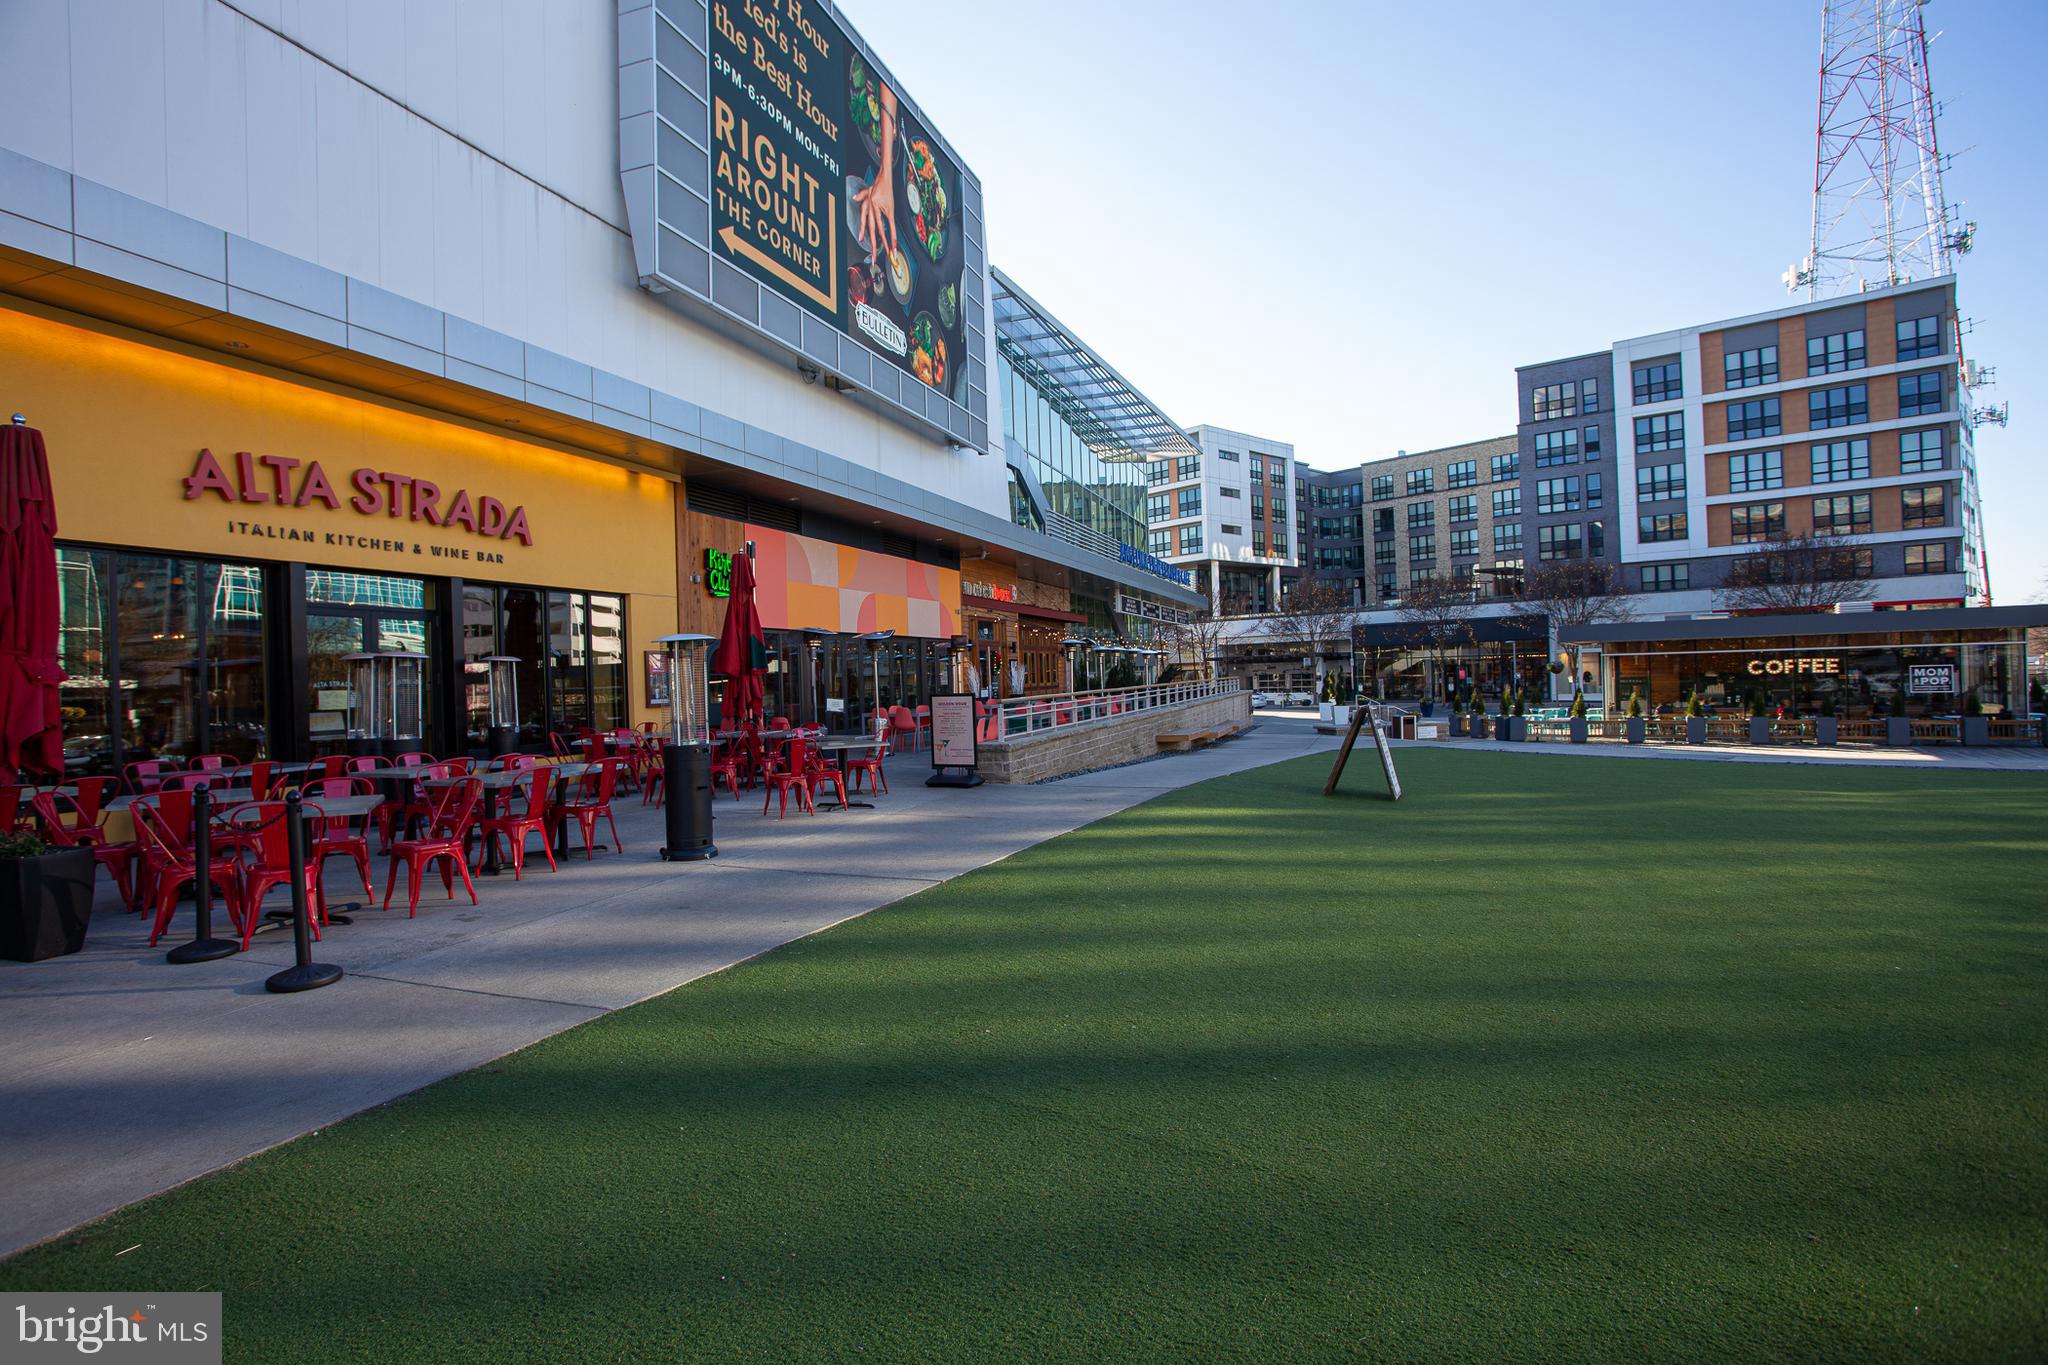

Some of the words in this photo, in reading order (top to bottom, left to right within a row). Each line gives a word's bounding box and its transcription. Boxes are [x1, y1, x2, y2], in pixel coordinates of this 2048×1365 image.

[787, 0, 829, 58] Hour
[793, 38, 807, 73] is
[714, 2, 747, 54] the
[753, 37, 792, 99] Best
[796, 80, 838, 142] Hour
[714, 53, 792, 134] 3PM-6:30PM
[795, 126, 839, 177] MON-FRI
[715, 95, 820, 215] RIGHT
[717, 150, 821, 248] AROUND
[716, 187, 751, 230] THE
[757, 219, 821, 279] CORNER
[862, 310, 903, 349] BULLETIN
[183, 448, 341, 510] ALTA
[351, 468, 533, 546] STRADA
[228, 520, 315, 543] ITALIAN
[326, 532, 405, 553] KITCHEN
[413, 543, 422, 554] &
[431, 545, 470, 560] WINE
[476, 551, 505, 564] BAR
[710, 569, 731, 592] Clu
[1747, 658, 1840, 675] COFFEE
[1914, 668, 1949, 677] MOM
